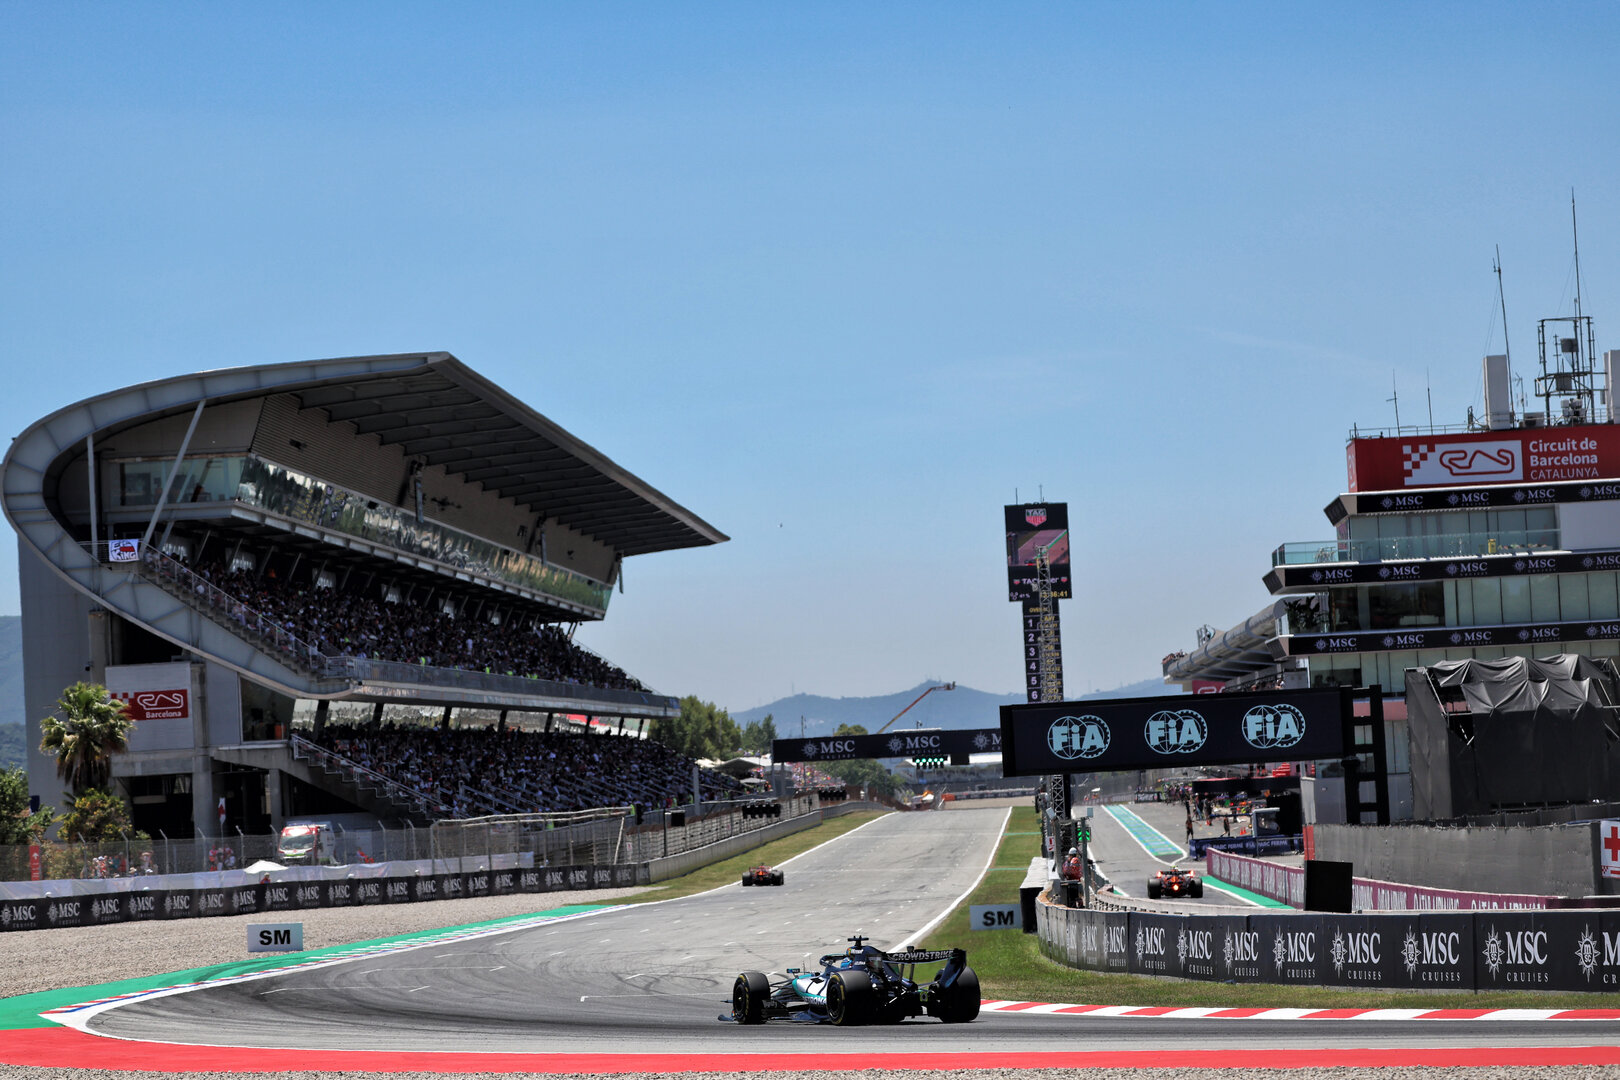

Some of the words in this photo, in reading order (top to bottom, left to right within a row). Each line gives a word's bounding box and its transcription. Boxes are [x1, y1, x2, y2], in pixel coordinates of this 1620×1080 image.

[1529, 438, 1578, 453] Circuit
[1580, 437, 1597, 450] de
[1530, 452, 1598, 467] Barcelona
[1530, 466, 1599, 480] CATALUNYA
[1528, 488, 1555, 499] MSC
[1594, 485, 1620, 495] MSC
[1396, 495, 1423, 506] MSC
[1462, 492, 1489, 502] MSC
[1460, 562, 1488, 572] MSC
[1528, 558, 1556, 569] MSC
[1325, 569, 1352, 579] MSC
[1393, 565, 1420, 575] MSC
[1028, 619, 1033, 628] 1
[1028, 633, 1035, 642] 2
[1464, 631, 1492, 641] MSC
[1532, 627, 1560, 638] MSC
[1329, 638, 1357, 648] MSC
[1397, 634, 1424, 645] MSC
[1029, 647, 1036, 656] 3
[1030, 662, 1037, 671] 4
[1031, 676, 1037, 685] 5
[1032, 691, 1038, 700] 6
[146, 710, 182, 719] Barcelona
[820, 740, 856, 754] MSC
[905, 736, 940, 748] MSC
[271, 887, 289, 901] MSC
[304, 886, 319, 900] MSC
[334, 884, 350, 898] MSC
[364, 883, 379, 896] MSC
[394, 882, 408, 895] MSC
[137, 896, 154, 911] MSC
[173, 895, 190, 909] MSC
[207, 893, 224, 908] MSC
[239, 890, 256, 905] MSC
[13, 905, 36, 920] MSC
[59, 902, 80, 918] MSC
[101, 899, 119, 914] MSC
[983, 911, 1014, 926] SM
[260, 930, 290, 945] SM
[1109, 926, 1126, 953] MSC
[1145, 927, 1165, 955] MSC
[1189, 930, 1212, 960] MSC
[1234, 931, 1258, 961] MSC
[1287, 932, 1315, 963] MSC
[1347, 932, 1380, 964] MSC
[1422, 932, 1460, 965] MSC
[1505, 930, 1547, 965] MSC
[892, 950, 954, 961] CROWDSTRIKE
[1189, 964, 1213, 975] CRUISES
[1234, 967, 1259, 977] CRUISES
[1287, 969, 1316, 978] CRUISES
[1348, 970, 1382, 981] CRUISES
[1422, 971, 1460, 981] CRUISES
